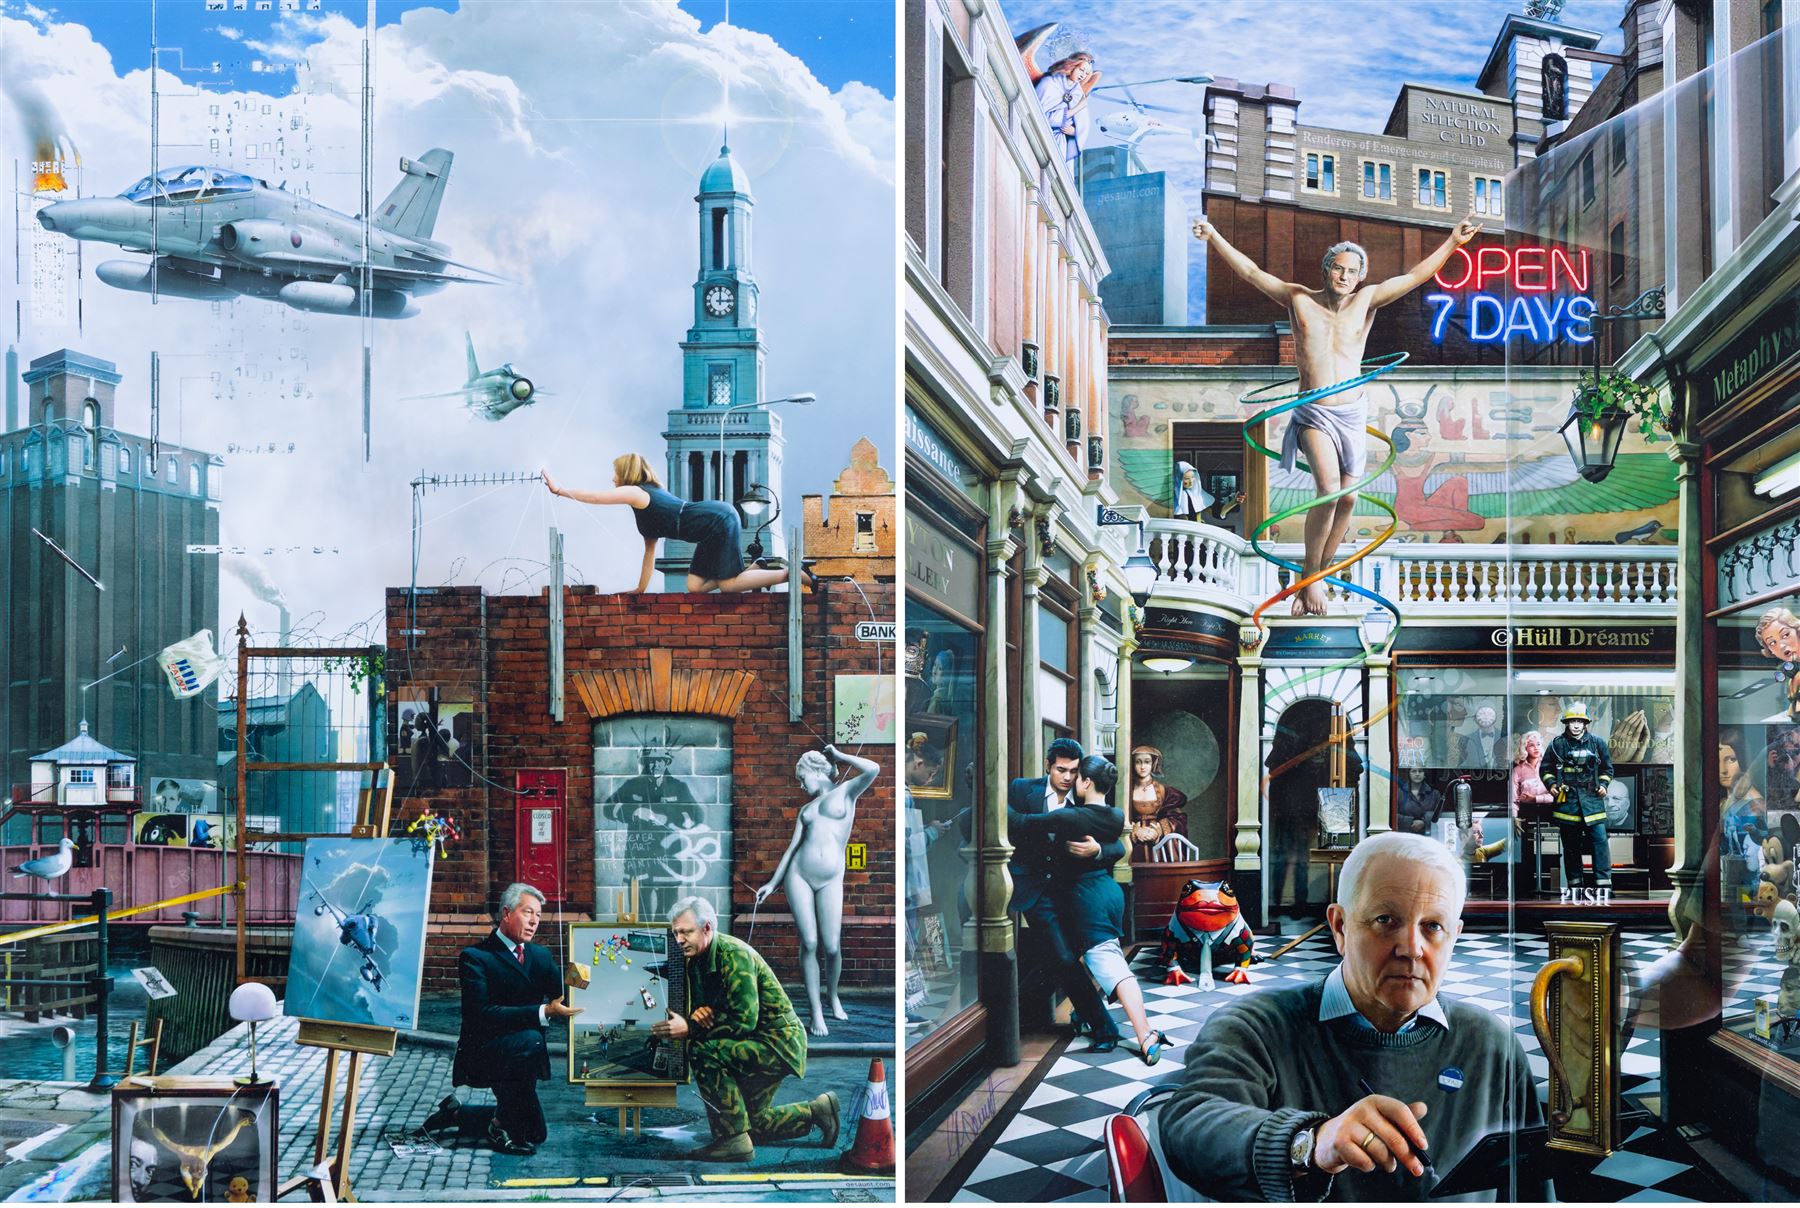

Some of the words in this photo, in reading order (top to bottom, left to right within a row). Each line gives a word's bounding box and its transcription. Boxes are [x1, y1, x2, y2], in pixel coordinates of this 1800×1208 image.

[1425, 96, 1499, 120] NATURAL
[1422, 112, 1501, 136] SELECTION
[1302, 130, 1357, 149] Renderers
[1359, 139, 1370, 151] of
[1372, 140, 1429, 162] Emergence
[1430, 151, 1449, 162] and
[1450, 152, 1506, 171] Complexity
[1459, 133, 1486, 147] LTD
[1097, 186, 1160, 206] gesaunt.com
[1433, 246, 1590, 292] OPEN
[1426, 293, 1455, 340] 7
[1469, 294, 1597, 343] DAYS
[861, 626, 896, 638] BANK
[1295, 633, 1332, 644] MARKET
[1515, 628, 1562, 646] Hüll
[170, 663, 188, 691] PAINT
[1560, 887, 1612, 907] PUSH
